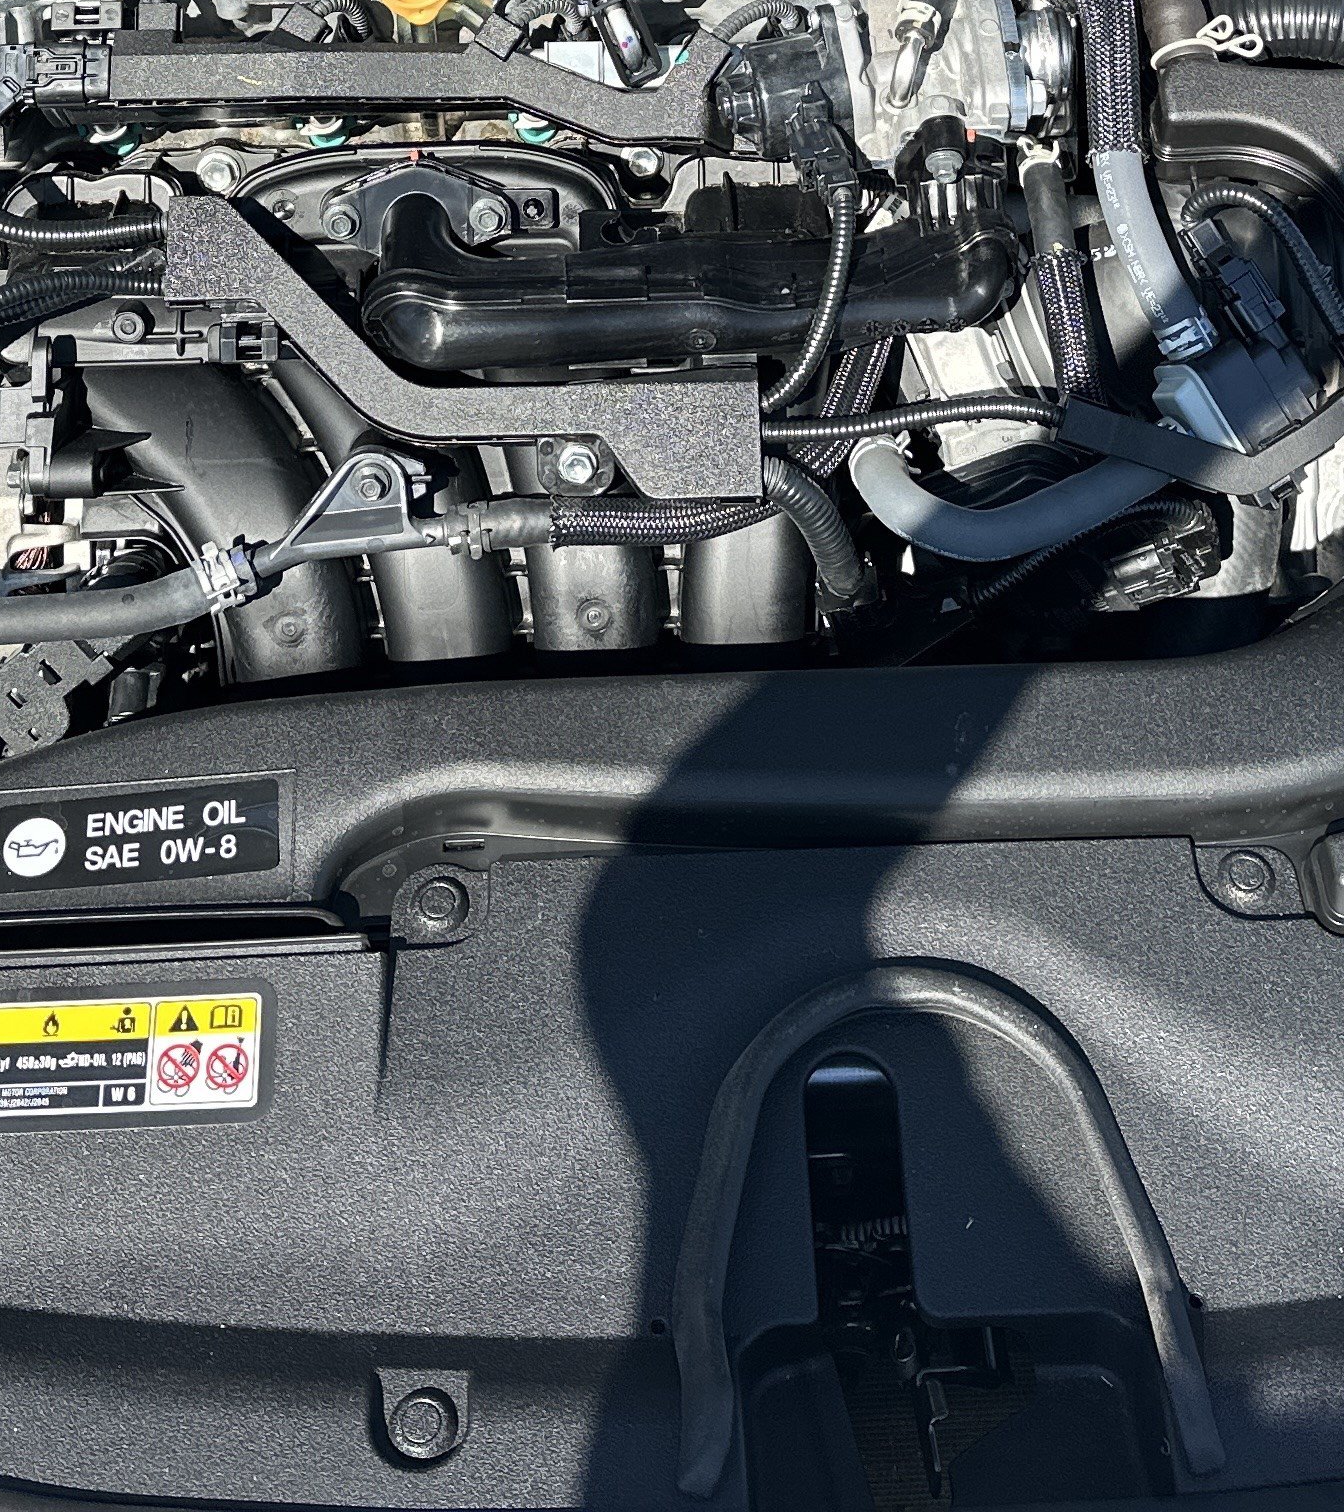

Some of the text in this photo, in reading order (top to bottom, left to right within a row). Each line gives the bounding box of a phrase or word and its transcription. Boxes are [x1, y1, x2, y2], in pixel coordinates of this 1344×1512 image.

[85, 799, 247, 838] ENGINE OIL
[84, 833, 238, 871] SAE 0W-8
[111, 1053, 122, 1066] 12
[123, 1051, 146, 1068] (PAG)
[1, 1087, 24, 1097] MOTOR
[24, 1086, 68, 1097] CORPORATION
